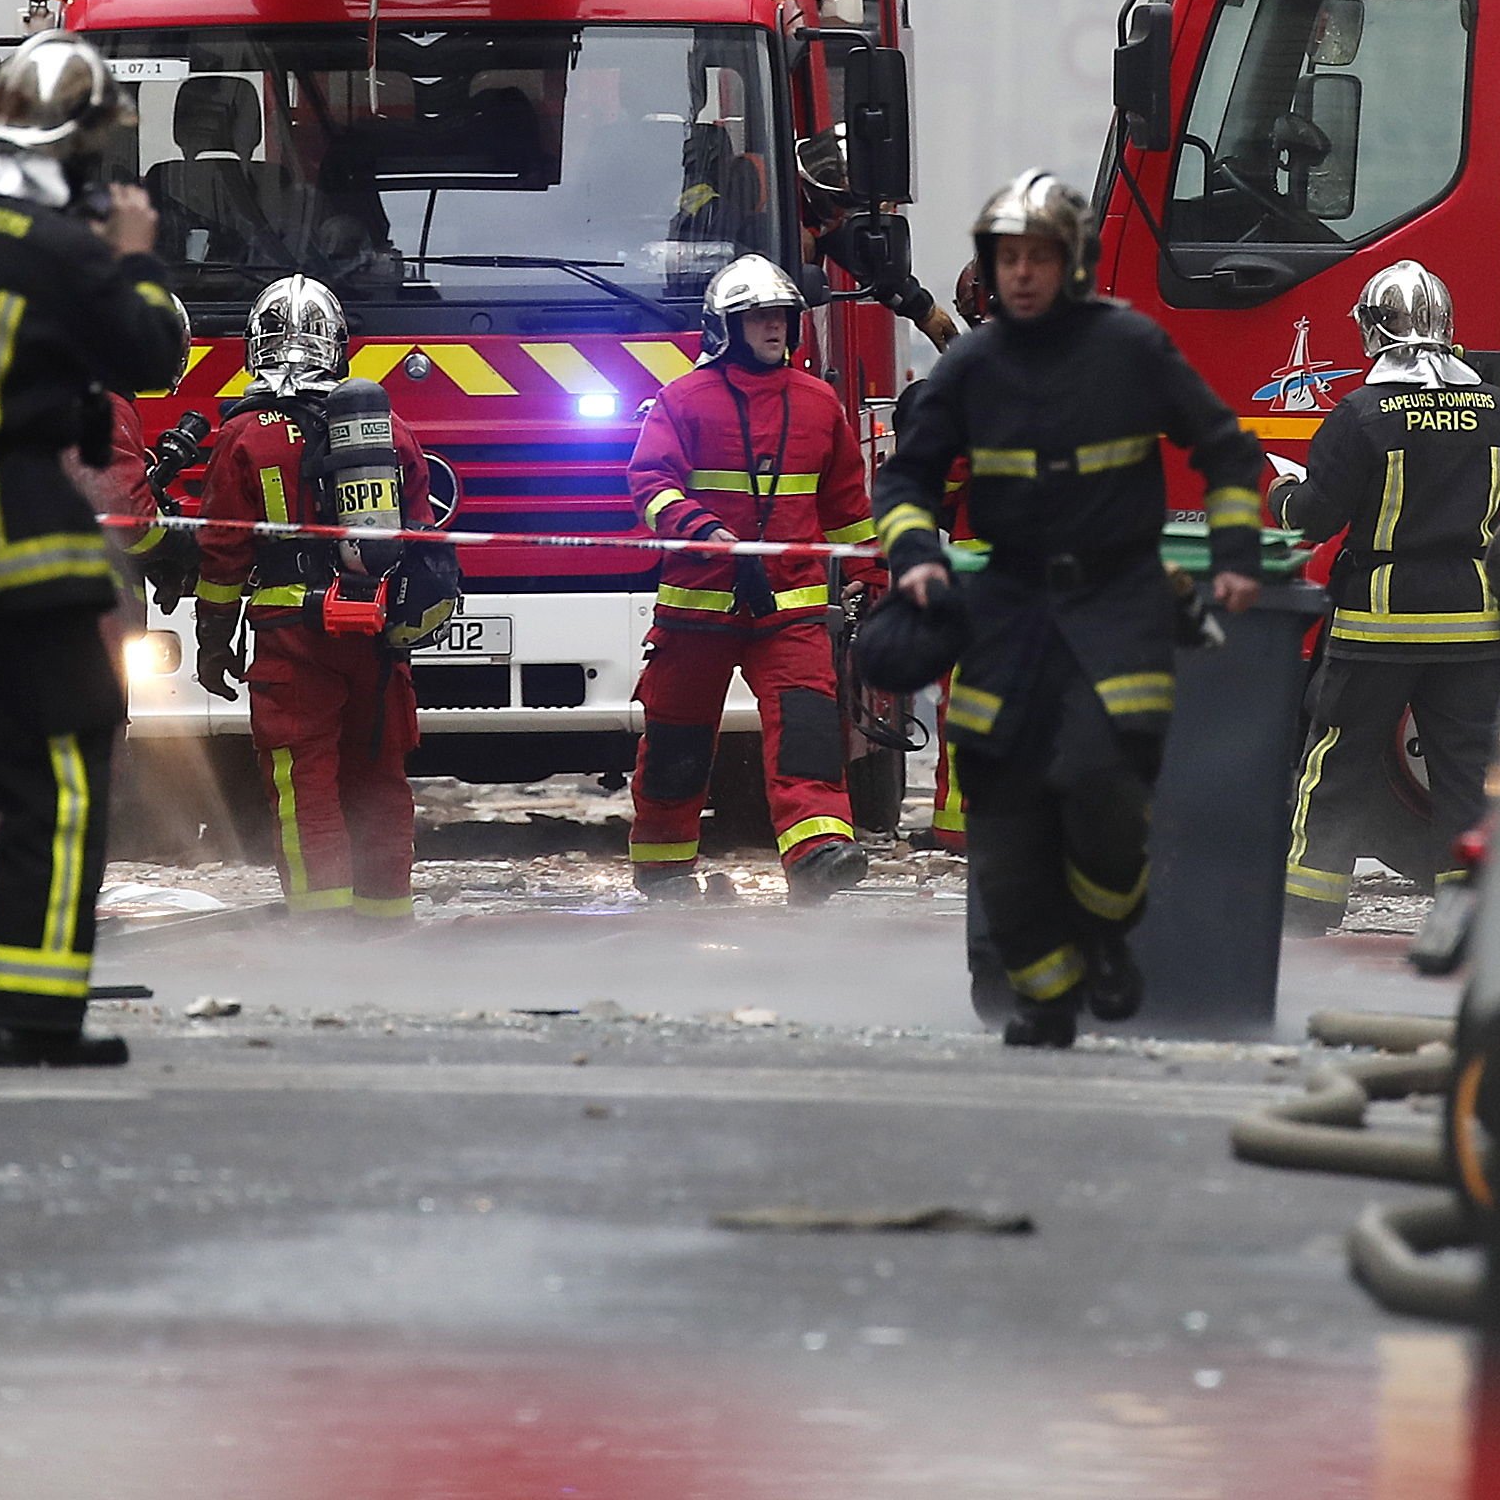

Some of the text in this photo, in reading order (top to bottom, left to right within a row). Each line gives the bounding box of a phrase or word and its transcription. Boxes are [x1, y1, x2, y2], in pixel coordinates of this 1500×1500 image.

[1380, 392, 1495, 413] SAPEURS POMPIERS
[363, 423, 389, 434] MSA
[1406, 410, 1478, 431] PARIS
[337, 483, 383, 513] BSPP
